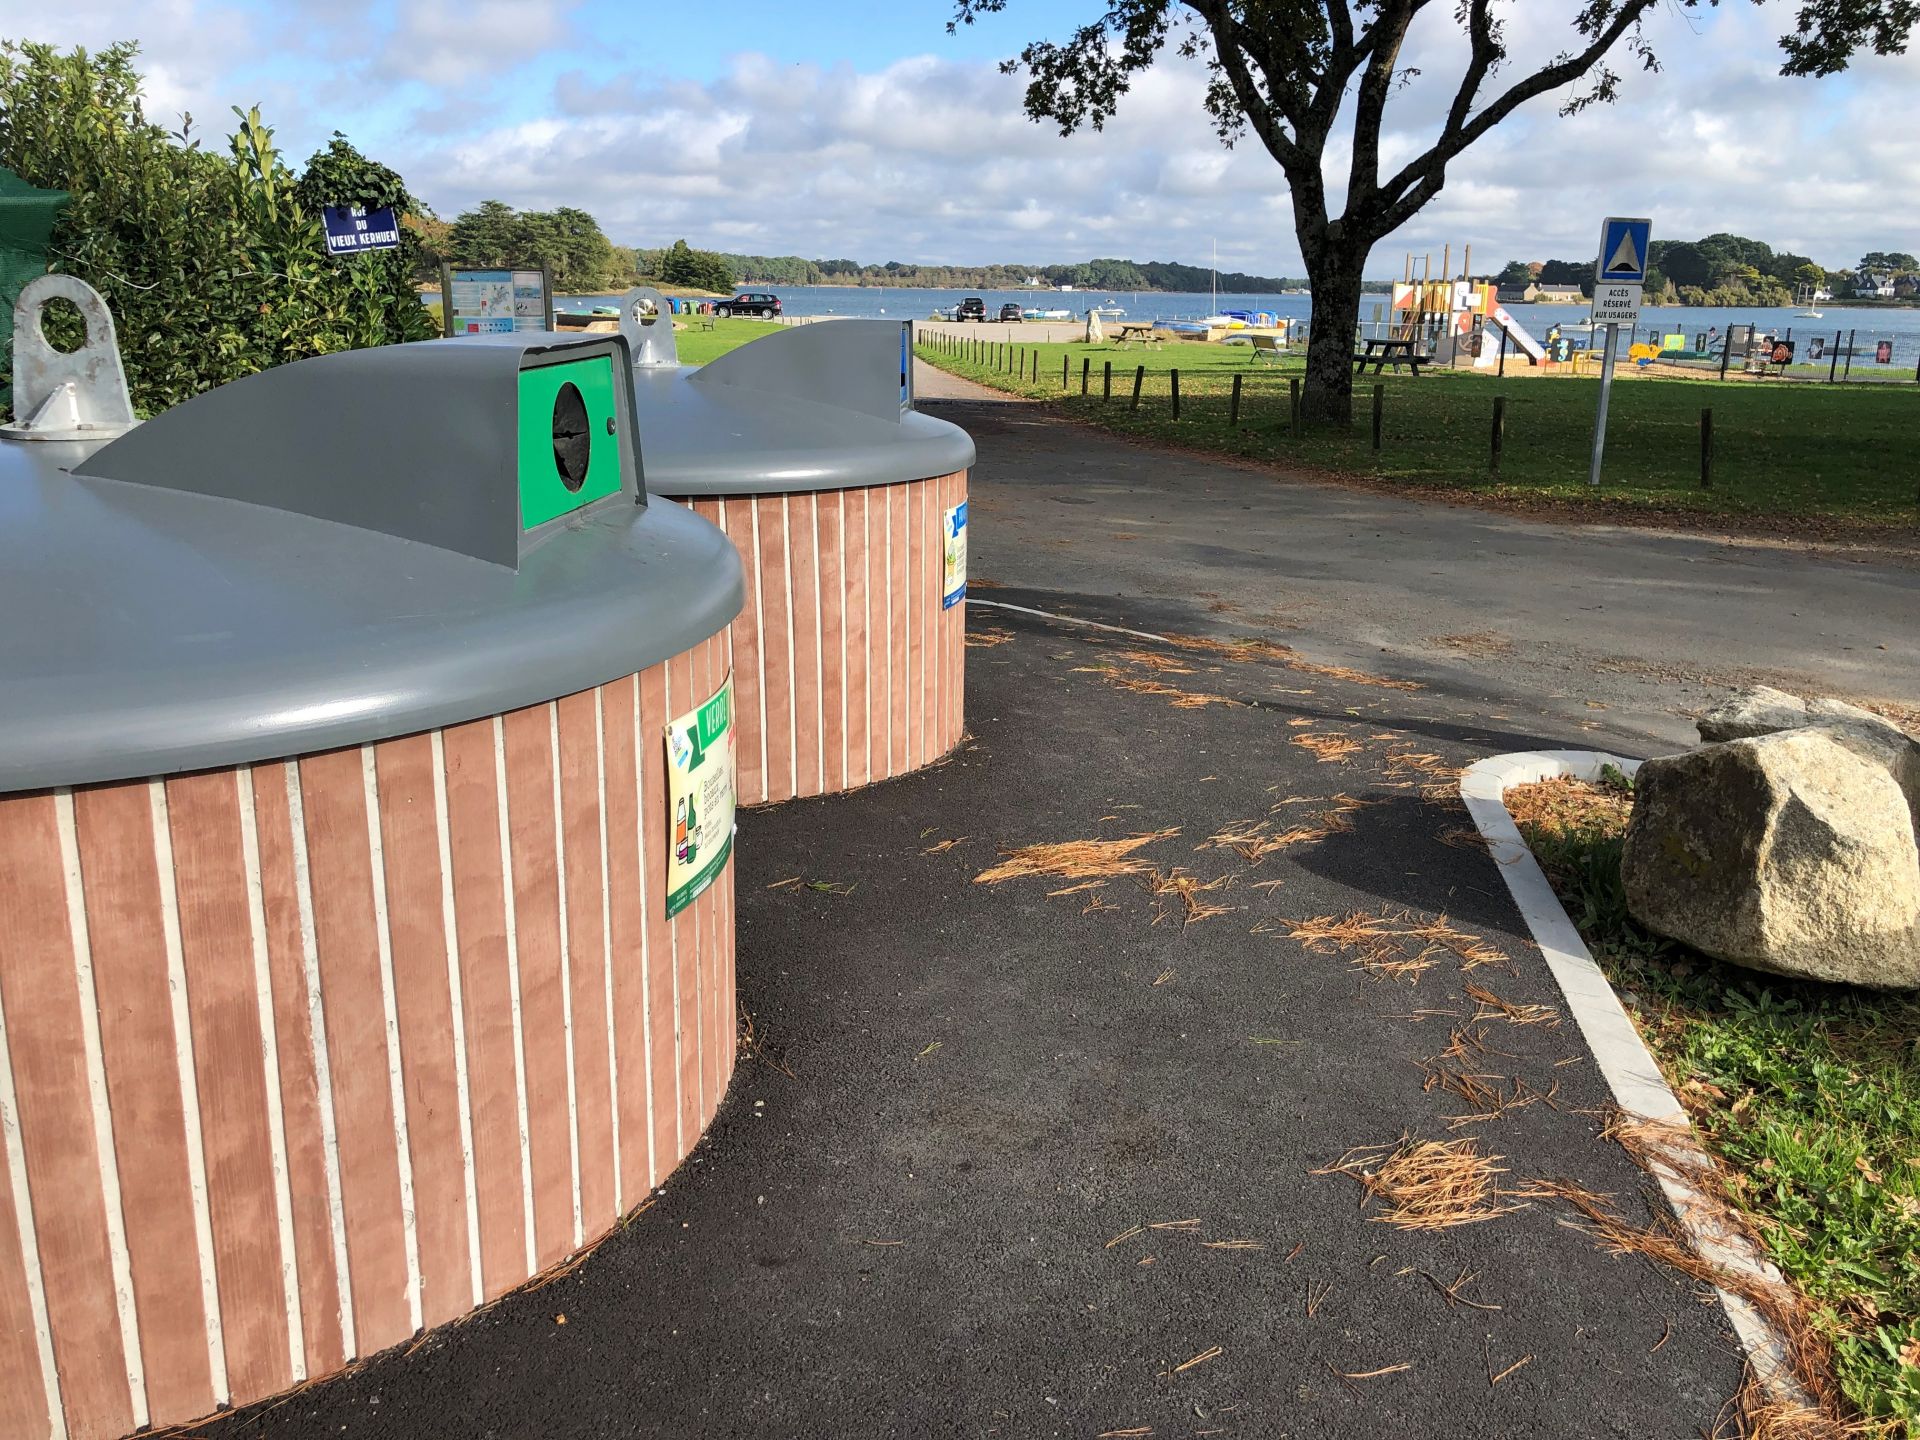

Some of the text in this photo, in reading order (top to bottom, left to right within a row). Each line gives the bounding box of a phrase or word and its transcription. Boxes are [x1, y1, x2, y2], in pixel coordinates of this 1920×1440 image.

[356, 220, 367, 230] DU
[330, 231, 397, 247] VIEUX KERHUEN
[1609, 288, 1629, 297] ACCÈS
[1603, 299, 1632, 308] RÉSERVÉ
[1595, 311, 1637, 319] AUX USAGERS
